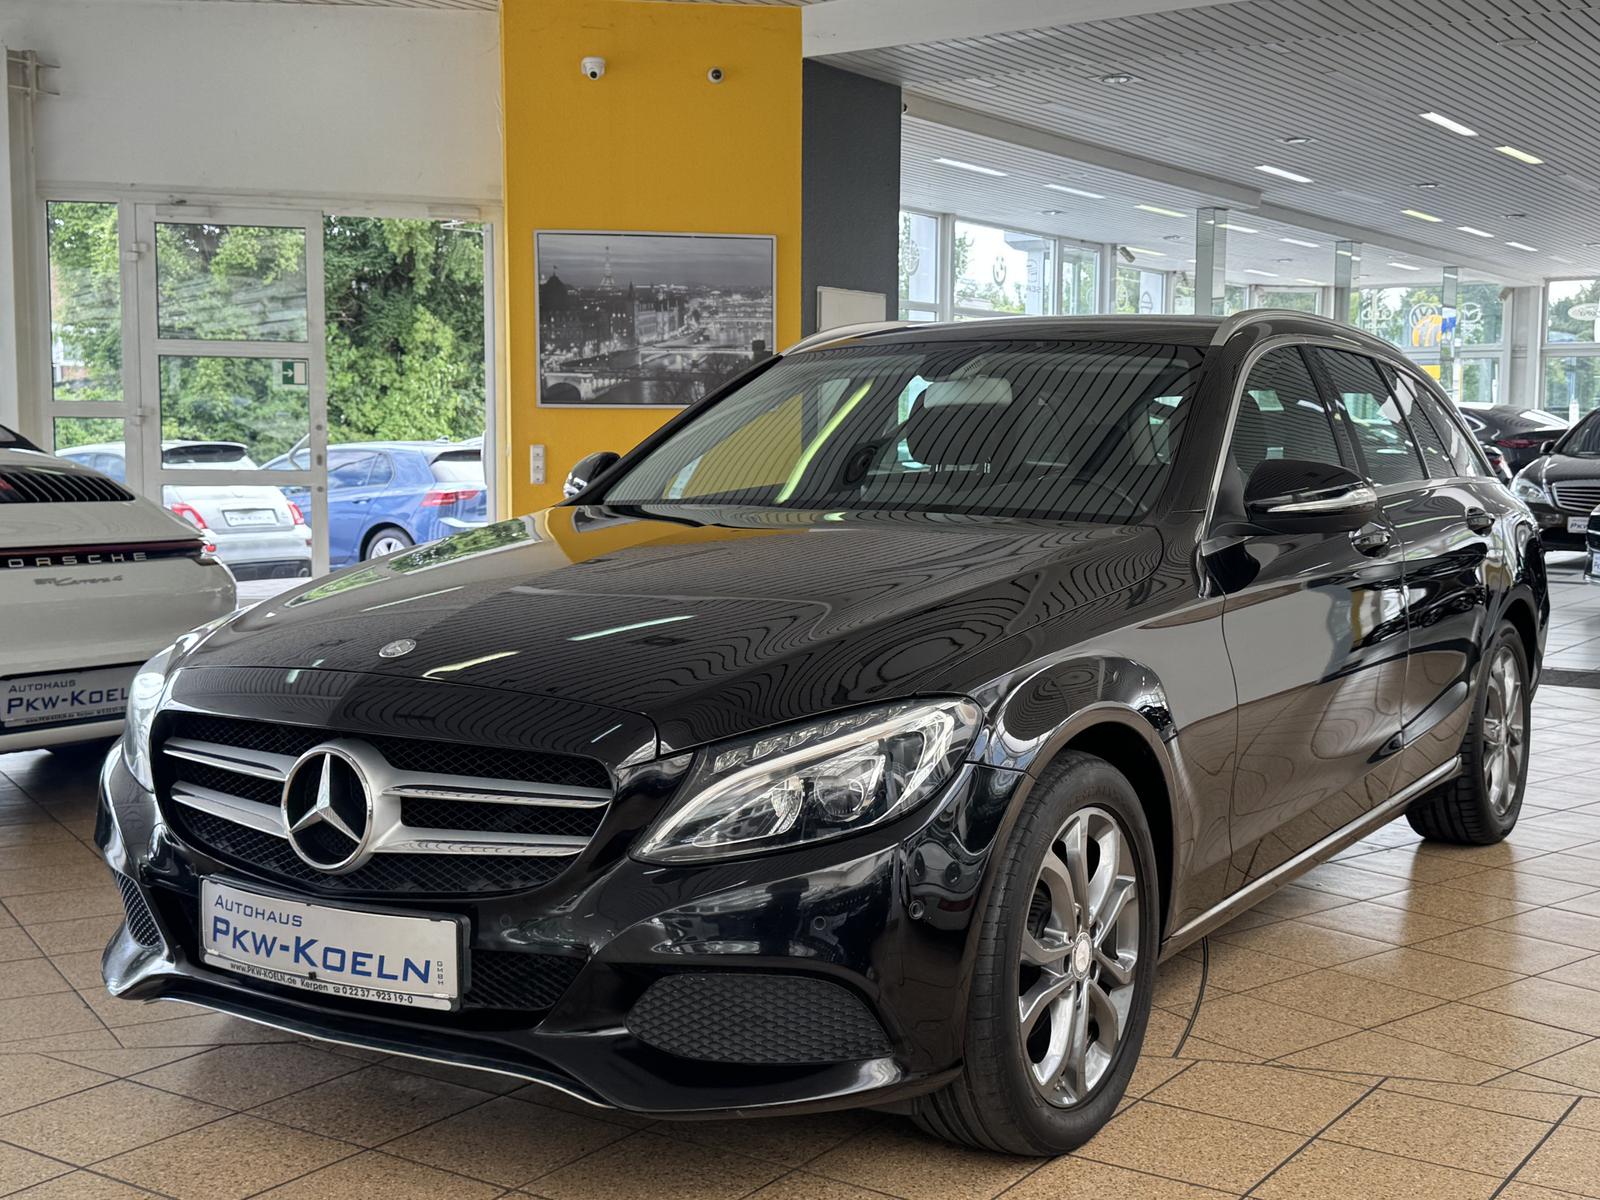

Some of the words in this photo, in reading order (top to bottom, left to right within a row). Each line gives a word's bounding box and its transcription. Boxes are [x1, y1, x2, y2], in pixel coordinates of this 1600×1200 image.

[8, 552, 148, 568] ORSCHE
[7, 687, 129, 714] PKW-KOEL
[300, 979, 329, 993] Kerpen
